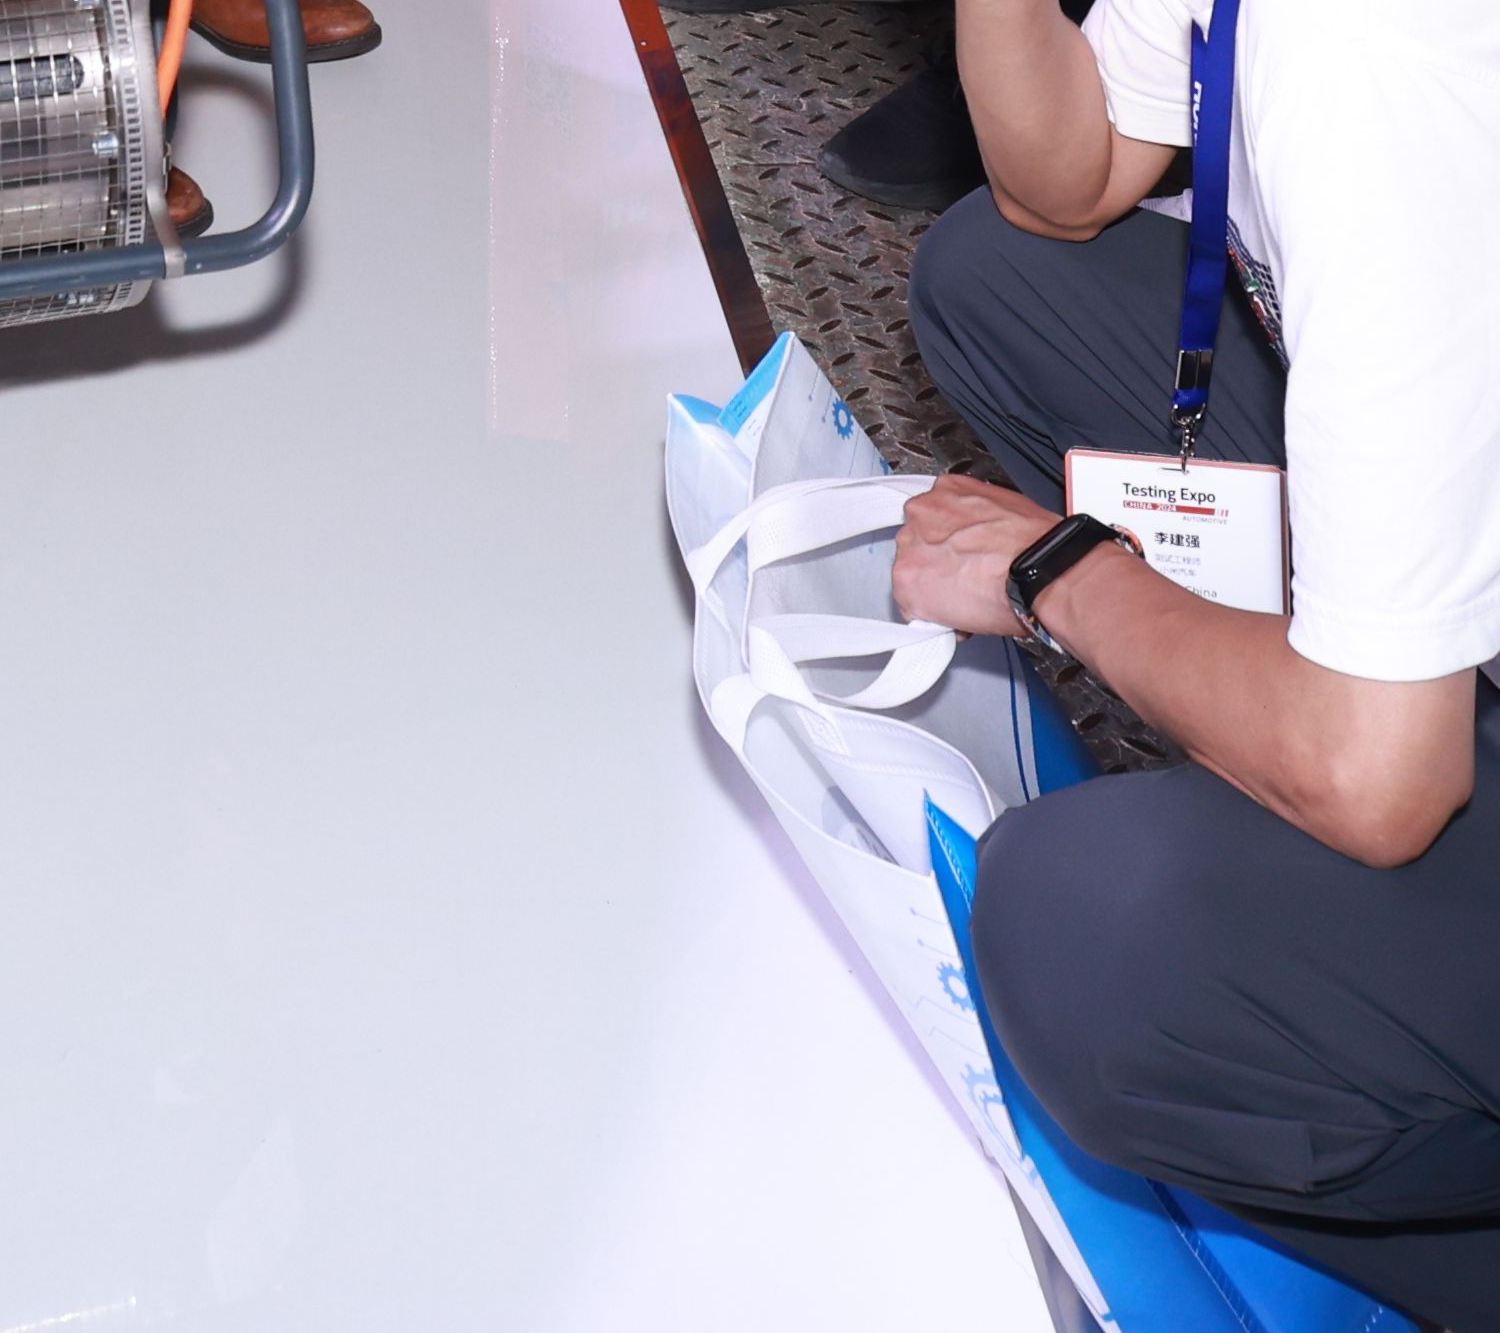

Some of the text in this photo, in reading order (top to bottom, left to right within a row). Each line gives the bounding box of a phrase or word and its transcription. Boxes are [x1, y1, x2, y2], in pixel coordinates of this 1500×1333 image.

[1121, 481, 1217, 505] Testing Expo
[1122, 500, 1178, 513] CHINA 2024
[1181, 515, 1229, 526] AUTOMOTIVE
[1154, 531, 1202, 549] 李建强
